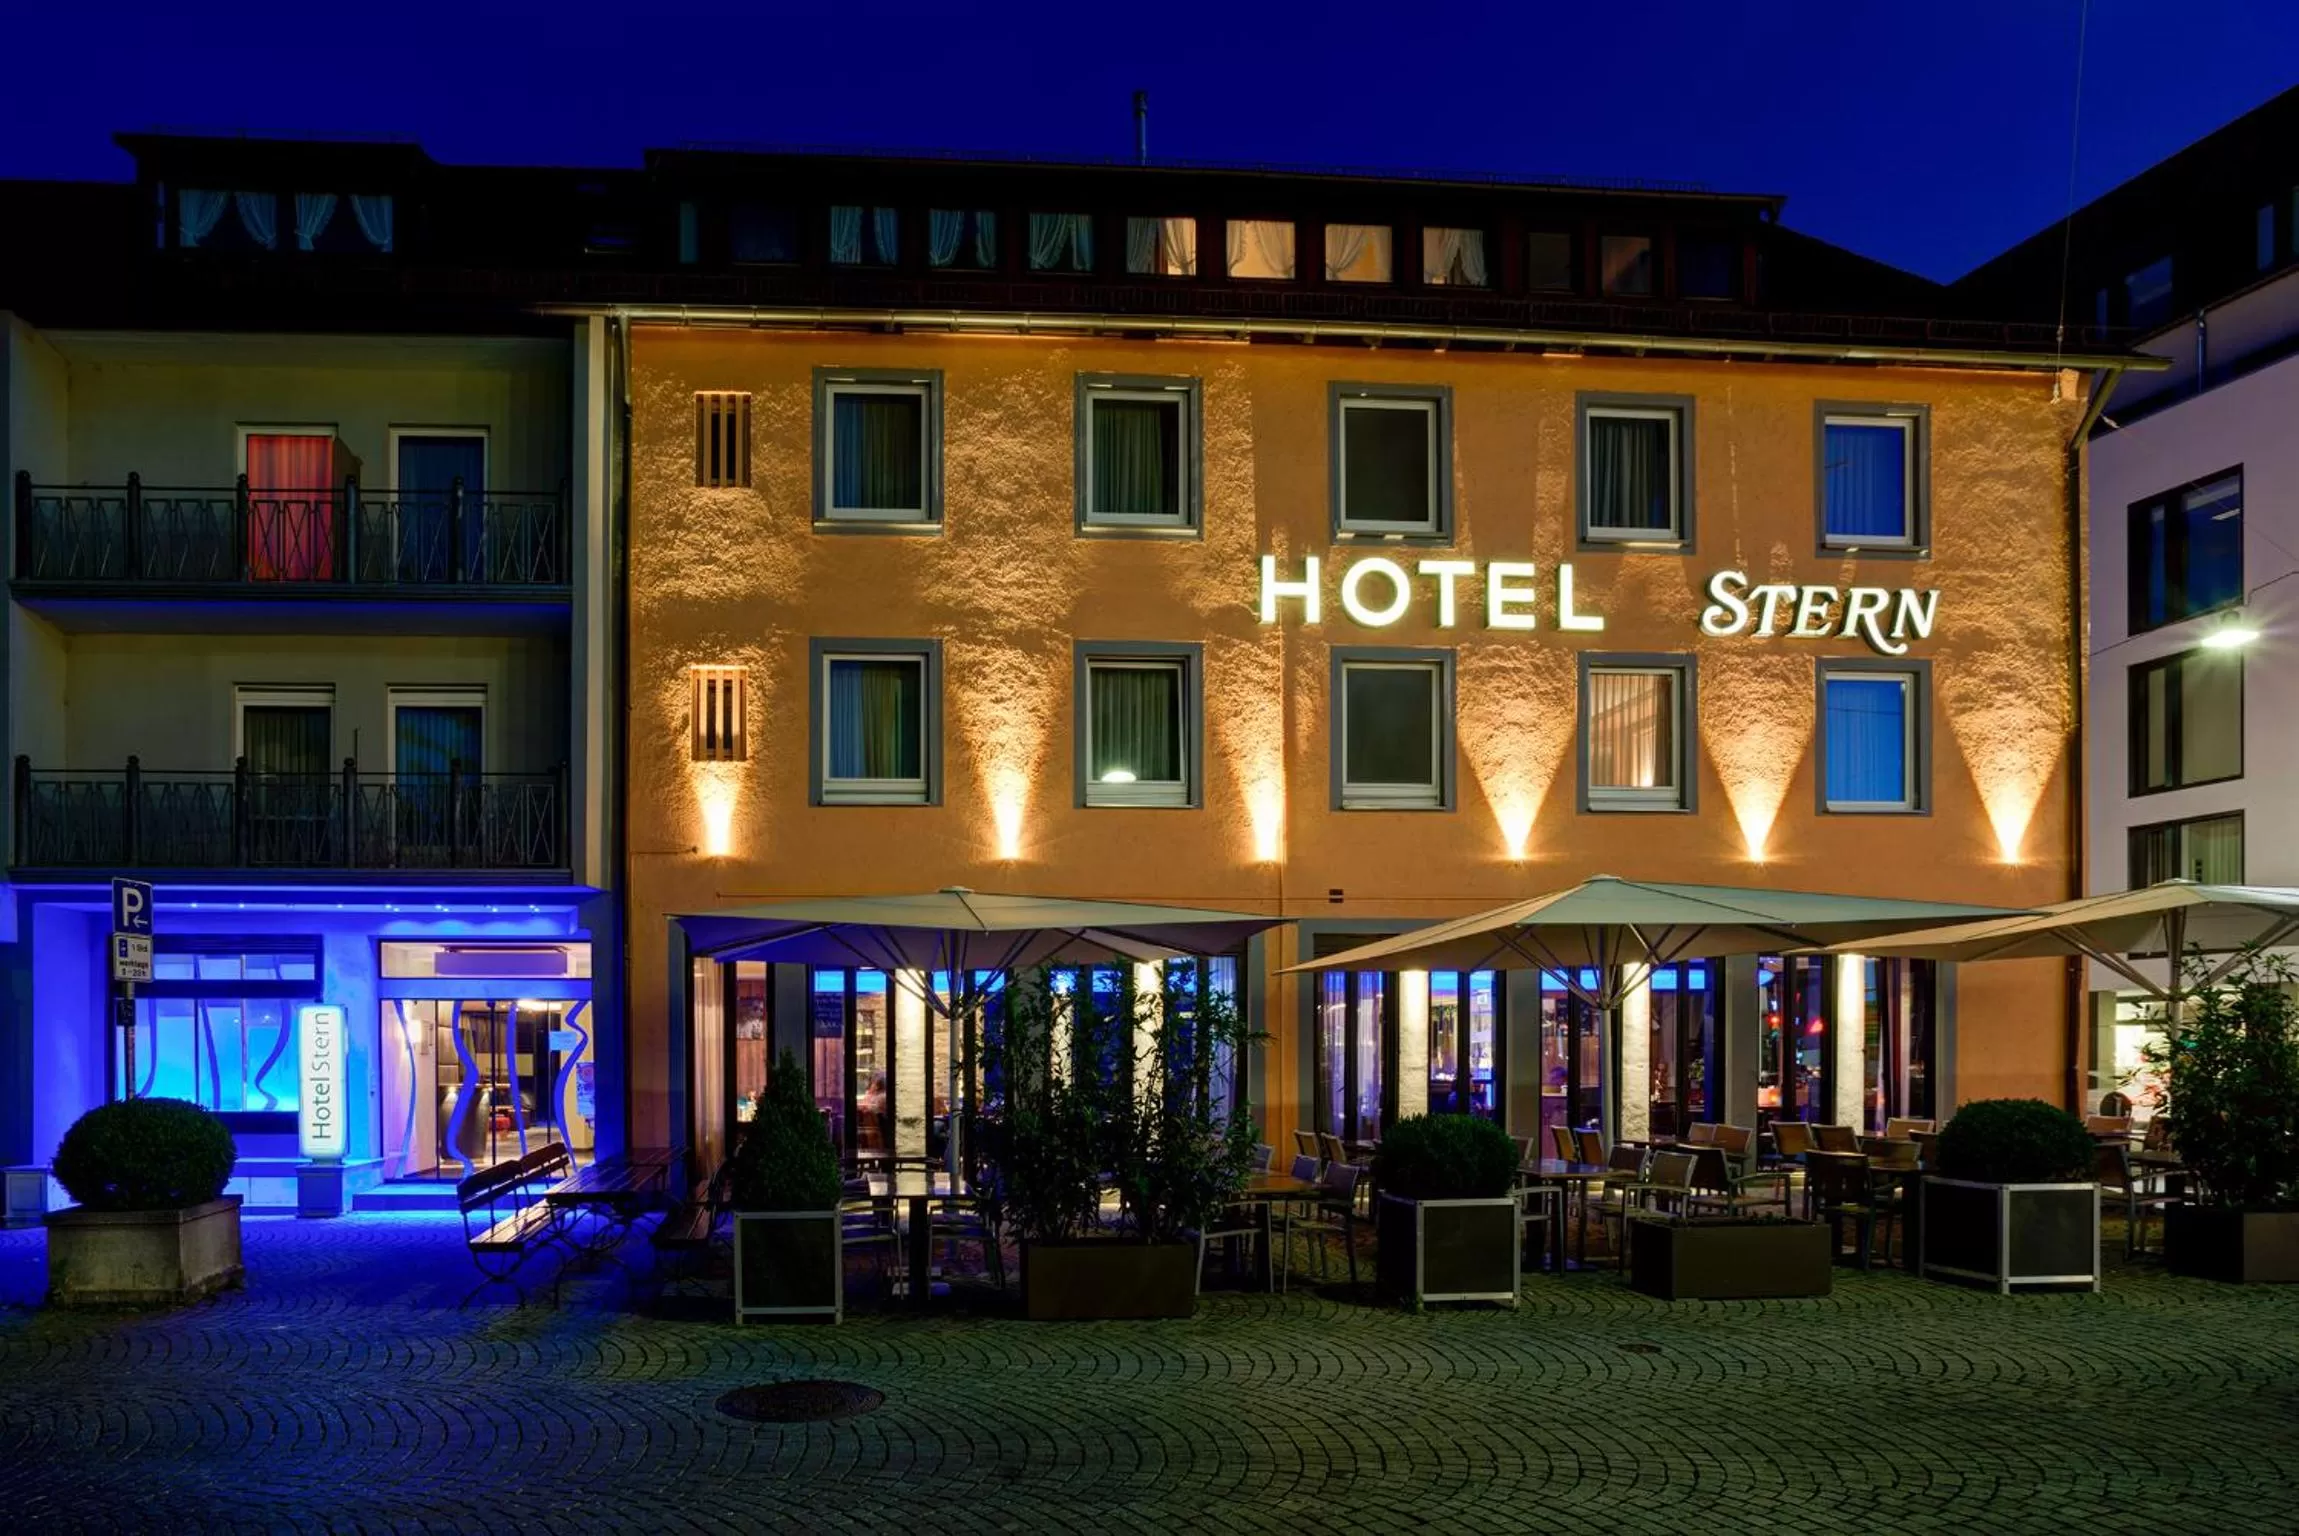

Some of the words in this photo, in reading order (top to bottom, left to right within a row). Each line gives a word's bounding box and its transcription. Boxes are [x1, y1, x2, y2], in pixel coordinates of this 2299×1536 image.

[1258, 554, 1606, 633] HOTEL
[1699, 569, 1940, 656] STERN
[122, 887, 143, 927] P
[311, 1012, 331, 1072] Stern
[309, 1077, 331, 1139] Hotel
